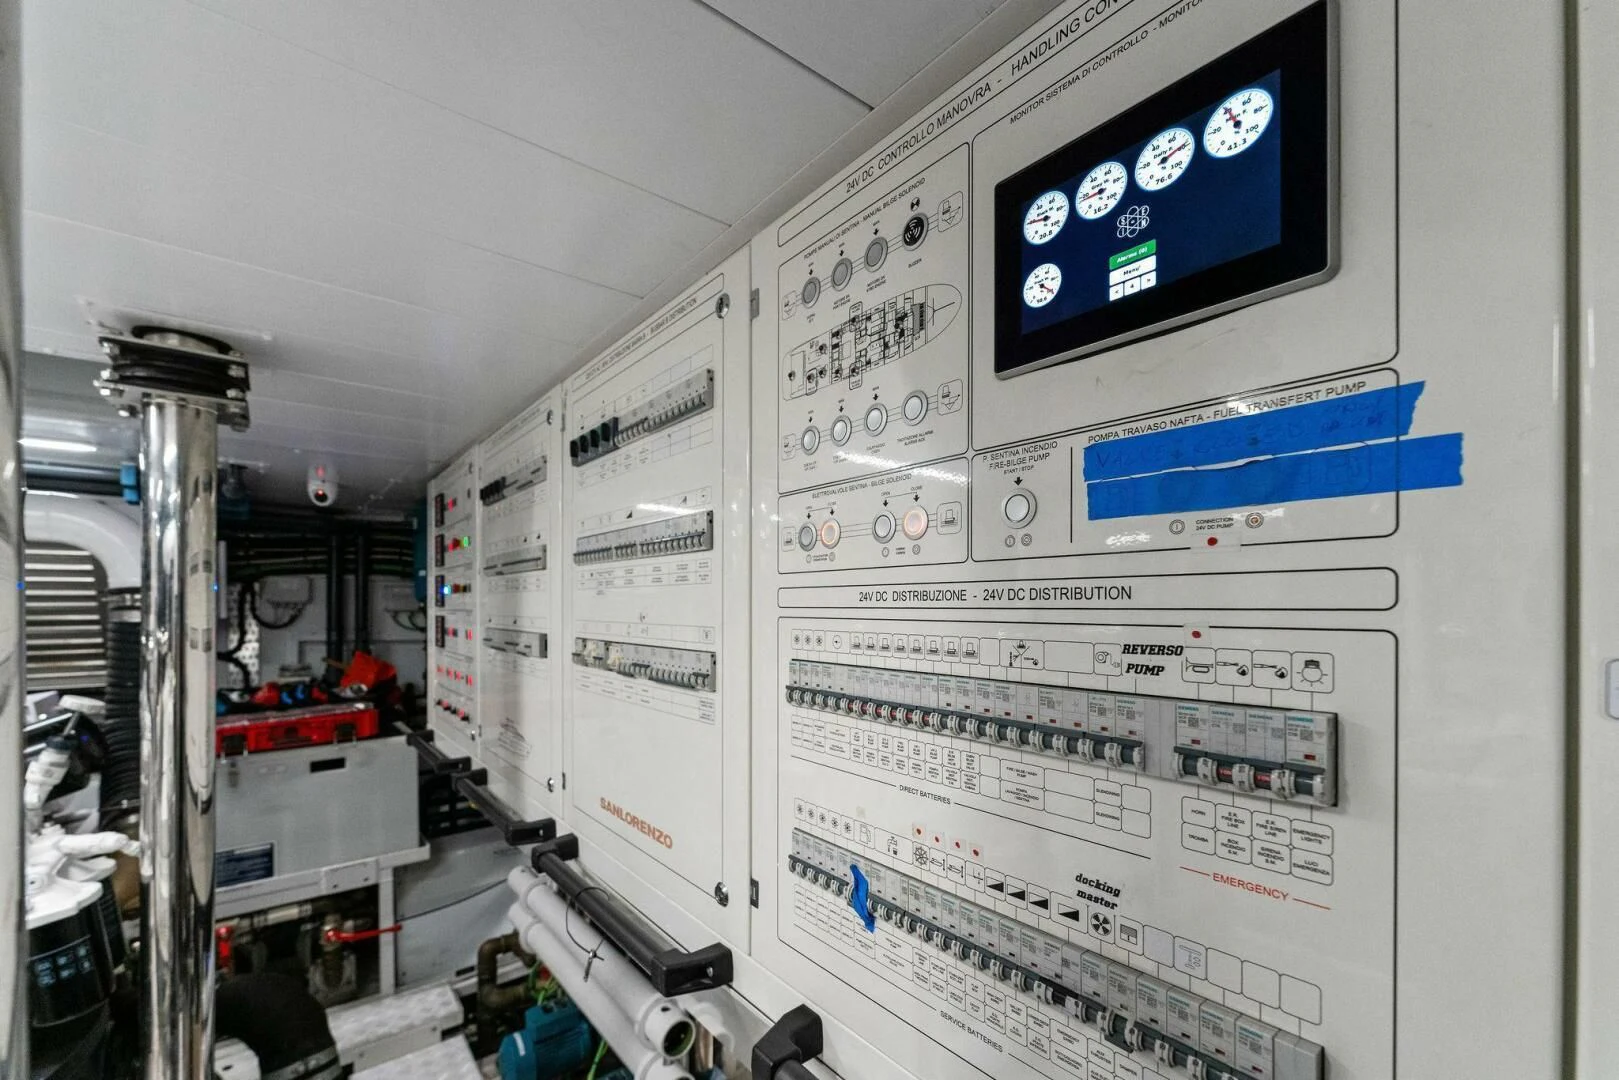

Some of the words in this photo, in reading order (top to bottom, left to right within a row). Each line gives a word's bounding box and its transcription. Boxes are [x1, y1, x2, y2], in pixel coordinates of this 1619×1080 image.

[1010, 97, 1045, 124] MONITOR
[1045, 74, 1081, 102] SISTEMA
[1081, 66, 1091, 79] DI
[1092, 29, 1149, 71] CONTROLLO
[1159, 0, 1202, 29] MONITO
[846, 176, 862, 193] 24V
[862, 166, 874, 182] DC
[877, 122, 935, 170] CONTROLLO
[936, 82, 992, 129] MANOVRA
[1011, 18, 1081, 76] HANDLING
[1245, 124, 1259, 134] 100
[1171, 161, 1182, 170] 100
[1155, 173, 1173, 185] 76.6
[863, 206, 882, 220] MANUAL
[883, 196, 898, 209] BILGE
[1094, 204, 1108, 214] 16.2
[1088, 432, 1120, 444] POMPA
[1122, 421, 1167, 436] TRAVASO
[1169, 414, 1204, 428] NAFTA
[1214, 406, 1242, 420] FUEL
[1246, 390, 1322, 414] TRANSFERT
[1326, 381, 1366, 399] PUMP
[990, 449, 1020, 461] SENTINA
[1022, 441, 1058, 454] INCENDIO
[989, 456, 1026, 470] FIRE-BILGE
[1028, 452, 1050, 462] PUMP
[848, 482, 868, 491] SENTINA
[871, 478, 885, 488] BILGE
[859, 591, 874, 602] 24V
[875, 591, 888, 602] DC
[892, 589, 967, 602] DISTRIBUZIONE
[983, 588, 1004, 601] 24V
[1008, 588, 1026, 601] DC
[1030, 586, 1132, 601] DISTRIBUTION
[1122, 644, 1184, 656] REVERSO
[1125, 663, 1165, 676] PUMP
[900, 784, 918, 796] DIRECT
[920, 790, 951, 804] BATTERIES
[600, 797, 673, 850] SANLORENZO
[1188, 834, 1208, 843] TROMBA
[1292, 828, 1330, 840] EMERGENCY
[1300, 836, 1322, 845] LIGHTS
[1293, 863, 1330, 876] EMERGENZA
[1075, 873, 1121, 898] docking
[1213, 872, 1289, 901] EMERGENCY
[1076, 888, 1118, 911] master
[940, 1010, 966, 1031] SERVICE
[968, 1026, 1003, 1052] BATTERIES
